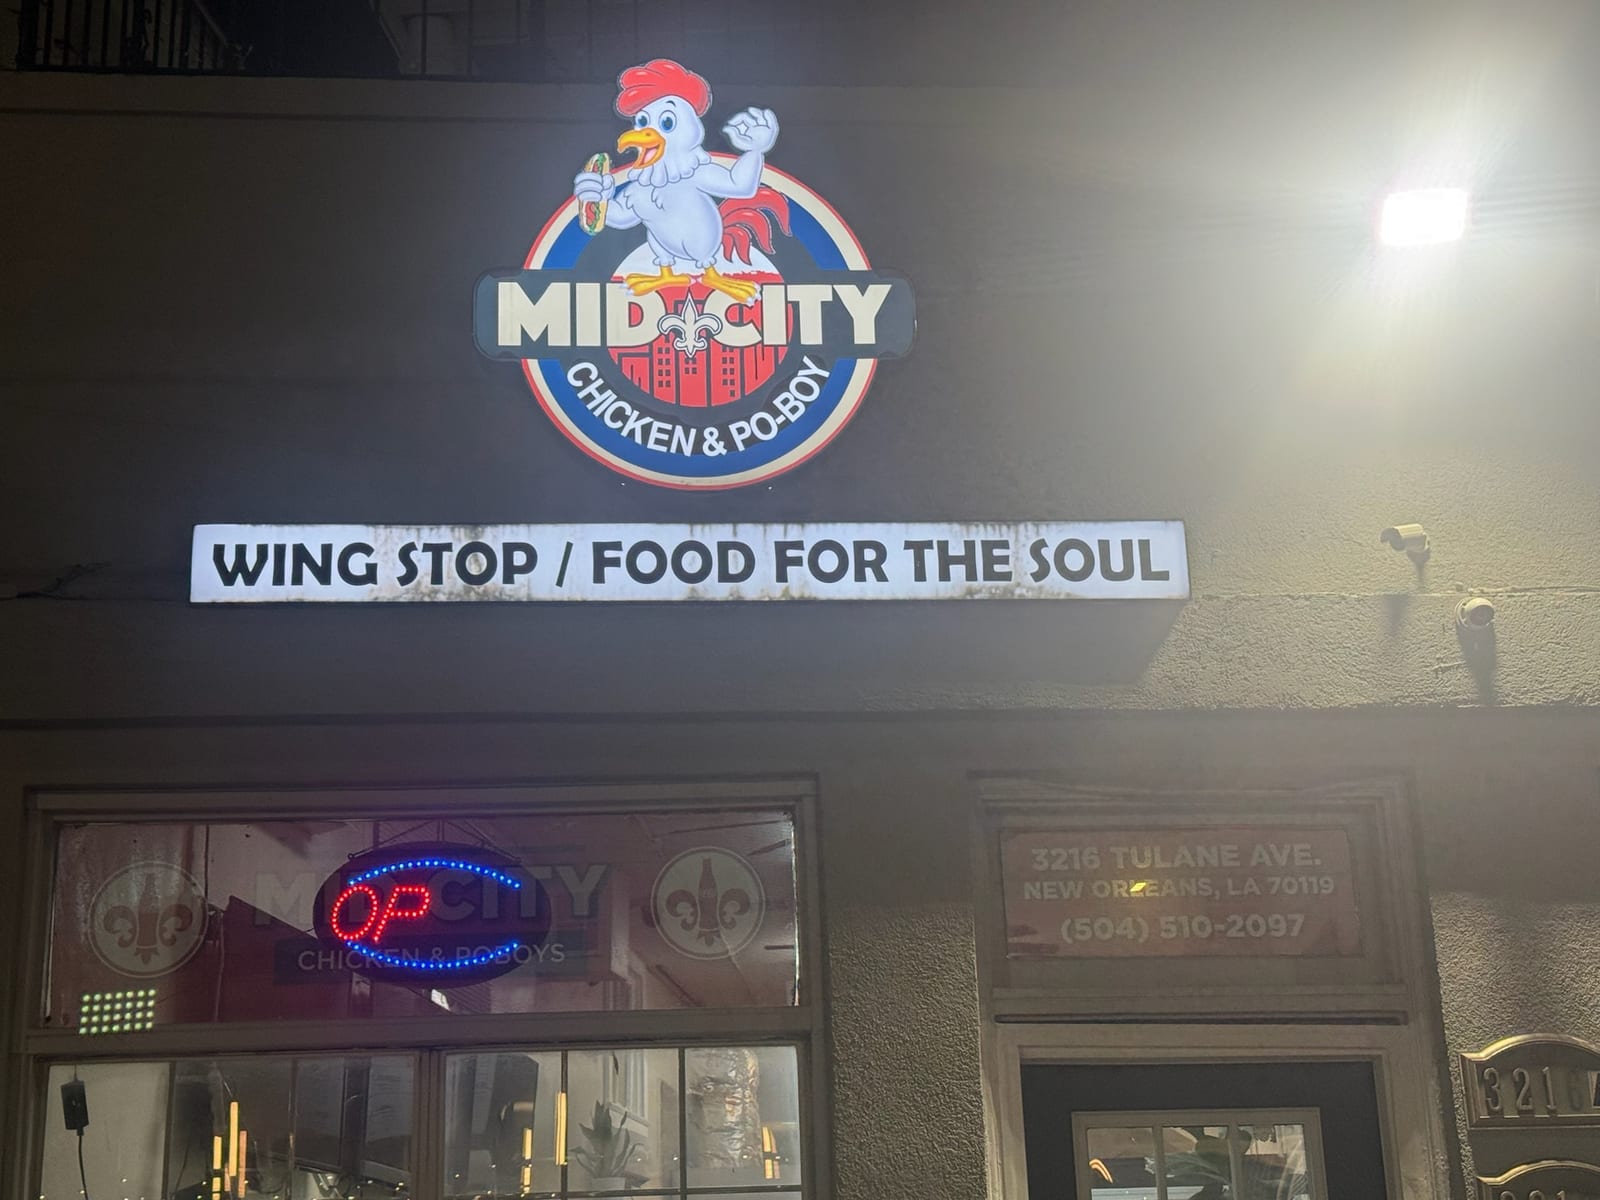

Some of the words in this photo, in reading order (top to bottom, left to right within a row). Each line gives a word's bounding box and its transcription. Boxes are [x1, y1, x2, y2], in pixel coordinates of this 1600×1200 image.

[497, 282, 666, 347] MID
[711, 283, 893, 348] CITY
[566, 361, 697, 457] CHICKEN
[702, 428, 728, 457] &
[732, 355, 831, 453] PO-BOY
[212, 541, 378, 587] WING
[396, 541, 538, 586] STOP
[555, 541, 574, 587] /
[592, 540, 756, 585] FOOD
[774, 539, 889, 583] FOR
[903, 539, 1014, 582] THE
[1029, 538, 1171, 583] SOUL
[1031, 847, 1100, 871] 3216
[1108, 845, 1241, 869] TULANE
[1250, 843, 1322, 867] AVE.
[432, 864, 608, 921] CITY
[1023, 880, 1084, 900] NEW
[1092, 879, 1220, 900] ORLEANS,
[1227, 877, 1261, 895] LA
[1268, 876, 1335, 895] 70119
[1060, 916, 1149, 944] (504)
[1159, 914, 1305, 939] 510-2097
[297, 948, 421, 971] CHICKEN
